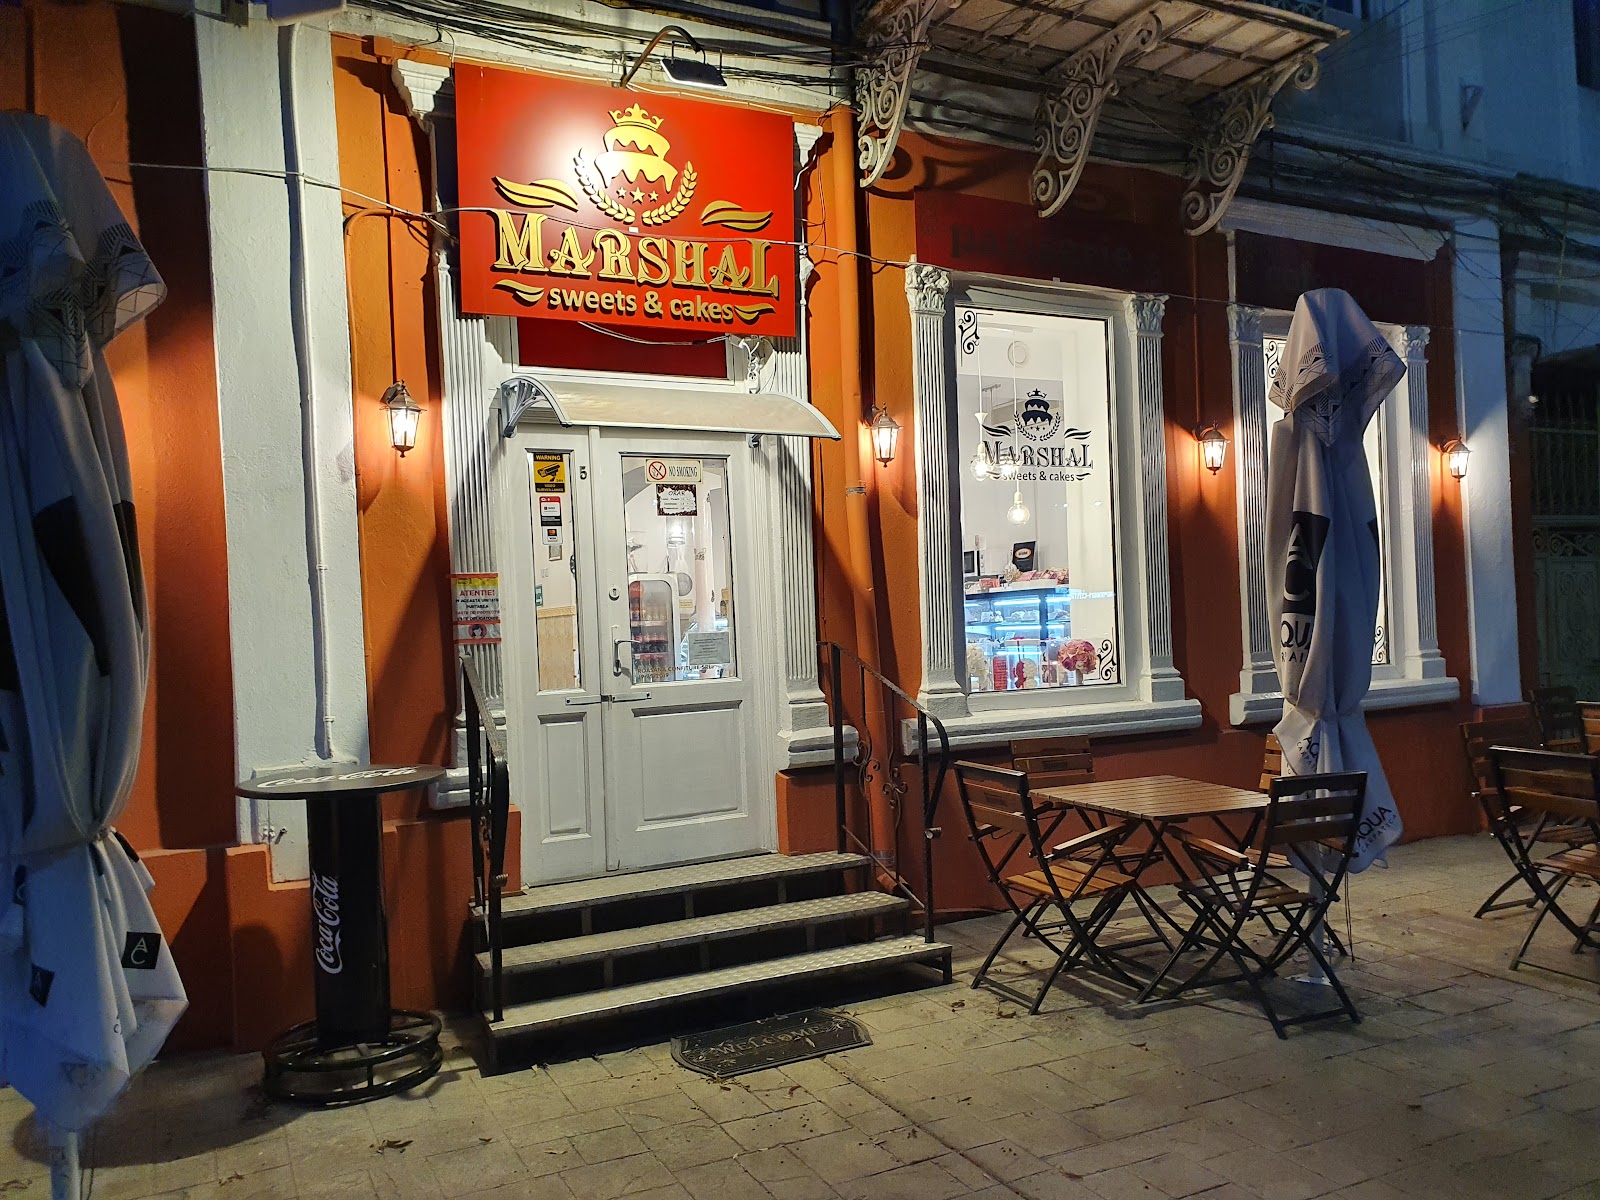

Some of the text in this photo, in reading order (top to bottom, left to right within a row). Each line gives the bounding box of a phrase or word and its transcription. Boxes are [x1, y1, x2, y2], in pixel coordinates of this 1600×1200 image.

[485, 209, 779, 299] MARSHAL
[549, 286, 735, 322] sweets & cakes
[579, 465, 588, 480] 5
[668, 466, 698, 478] NO SMOKING
[983, 440, 1094, 469] MARSHAL
[1003, 470, 1075, 482] sweets & cakes
[1356, 805, 1393, 848] AQUA
[1361, 814, 1397, 853] CARPATICA
[312, 869, 343, 974] Coca-Cola
